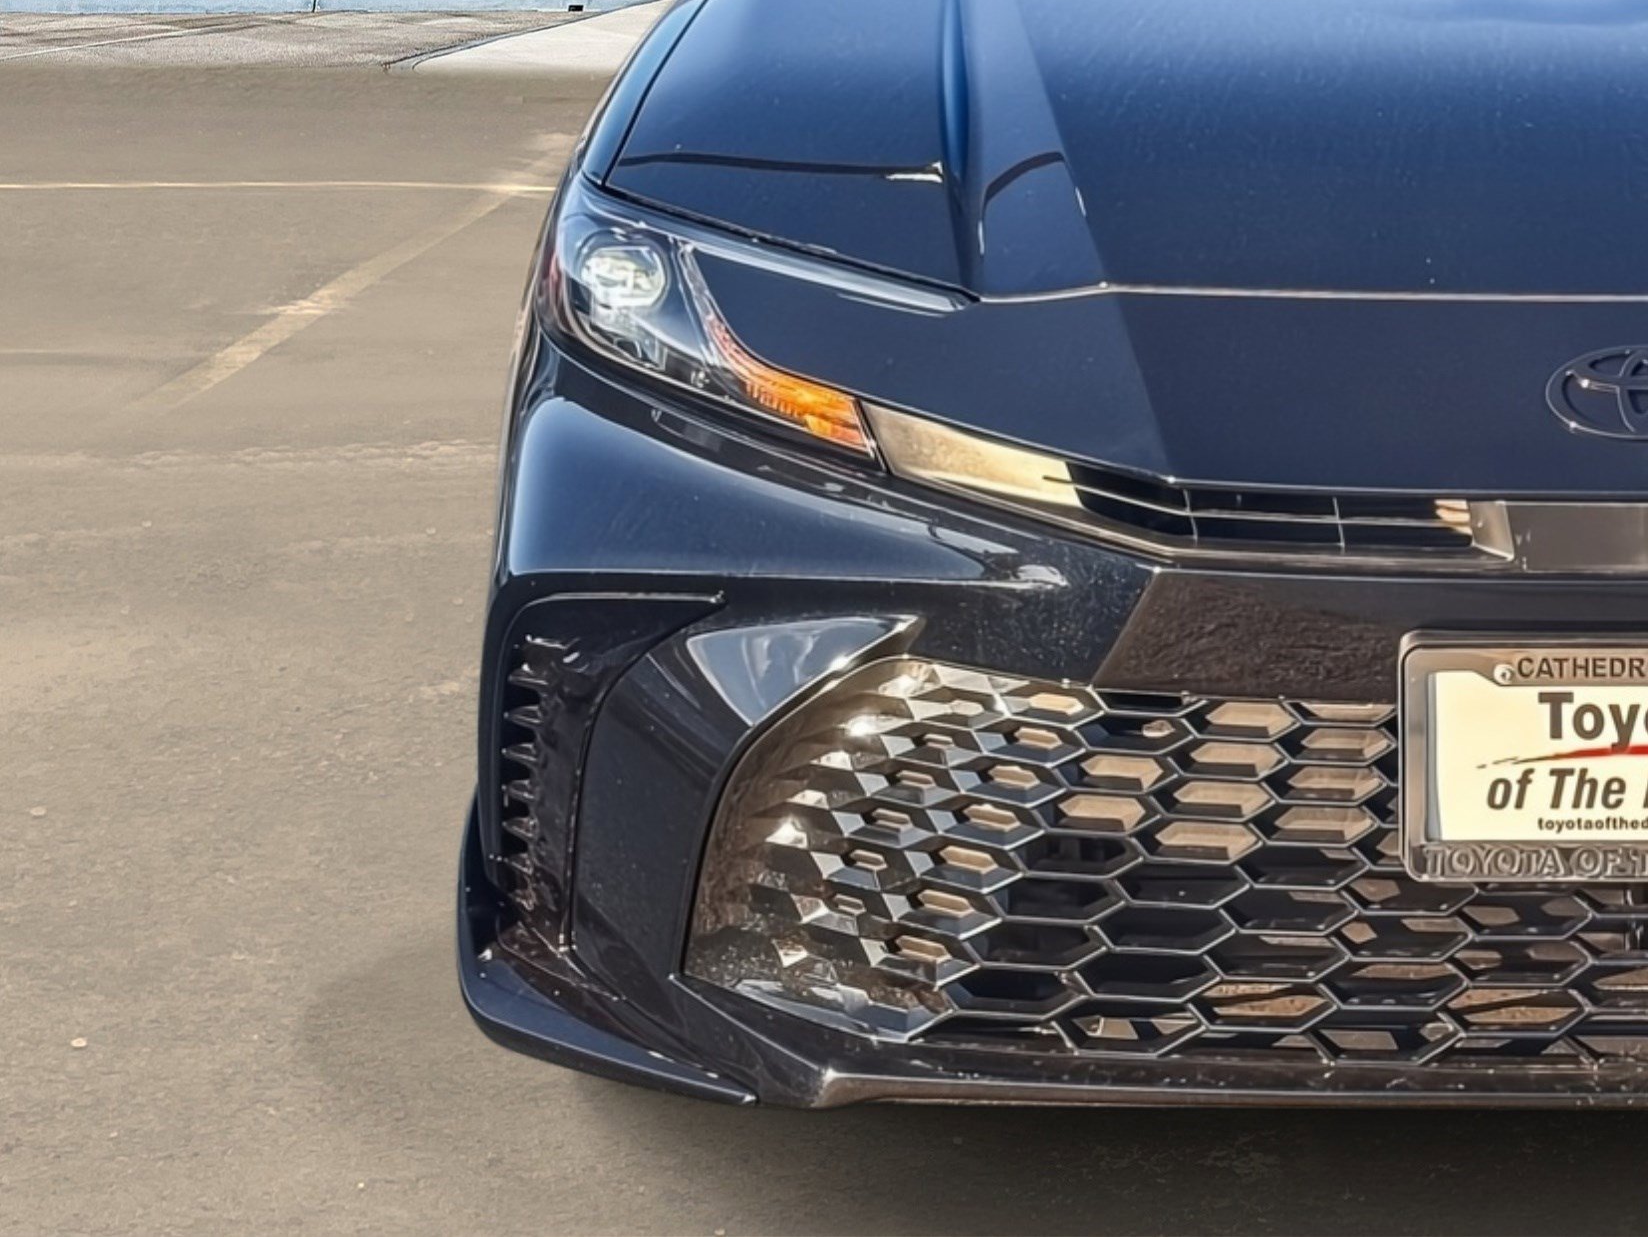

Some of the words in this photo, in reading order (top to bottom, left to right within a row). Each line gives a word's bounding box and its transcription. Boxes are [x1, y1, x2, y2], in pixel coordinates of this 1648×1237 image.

[1486, 767, 1535, 810] of
[1548, 767, 1627, 810] The
[1424, 846, 1566, 878] TOYOTA
[1570, 846, 1622, 878] OF
